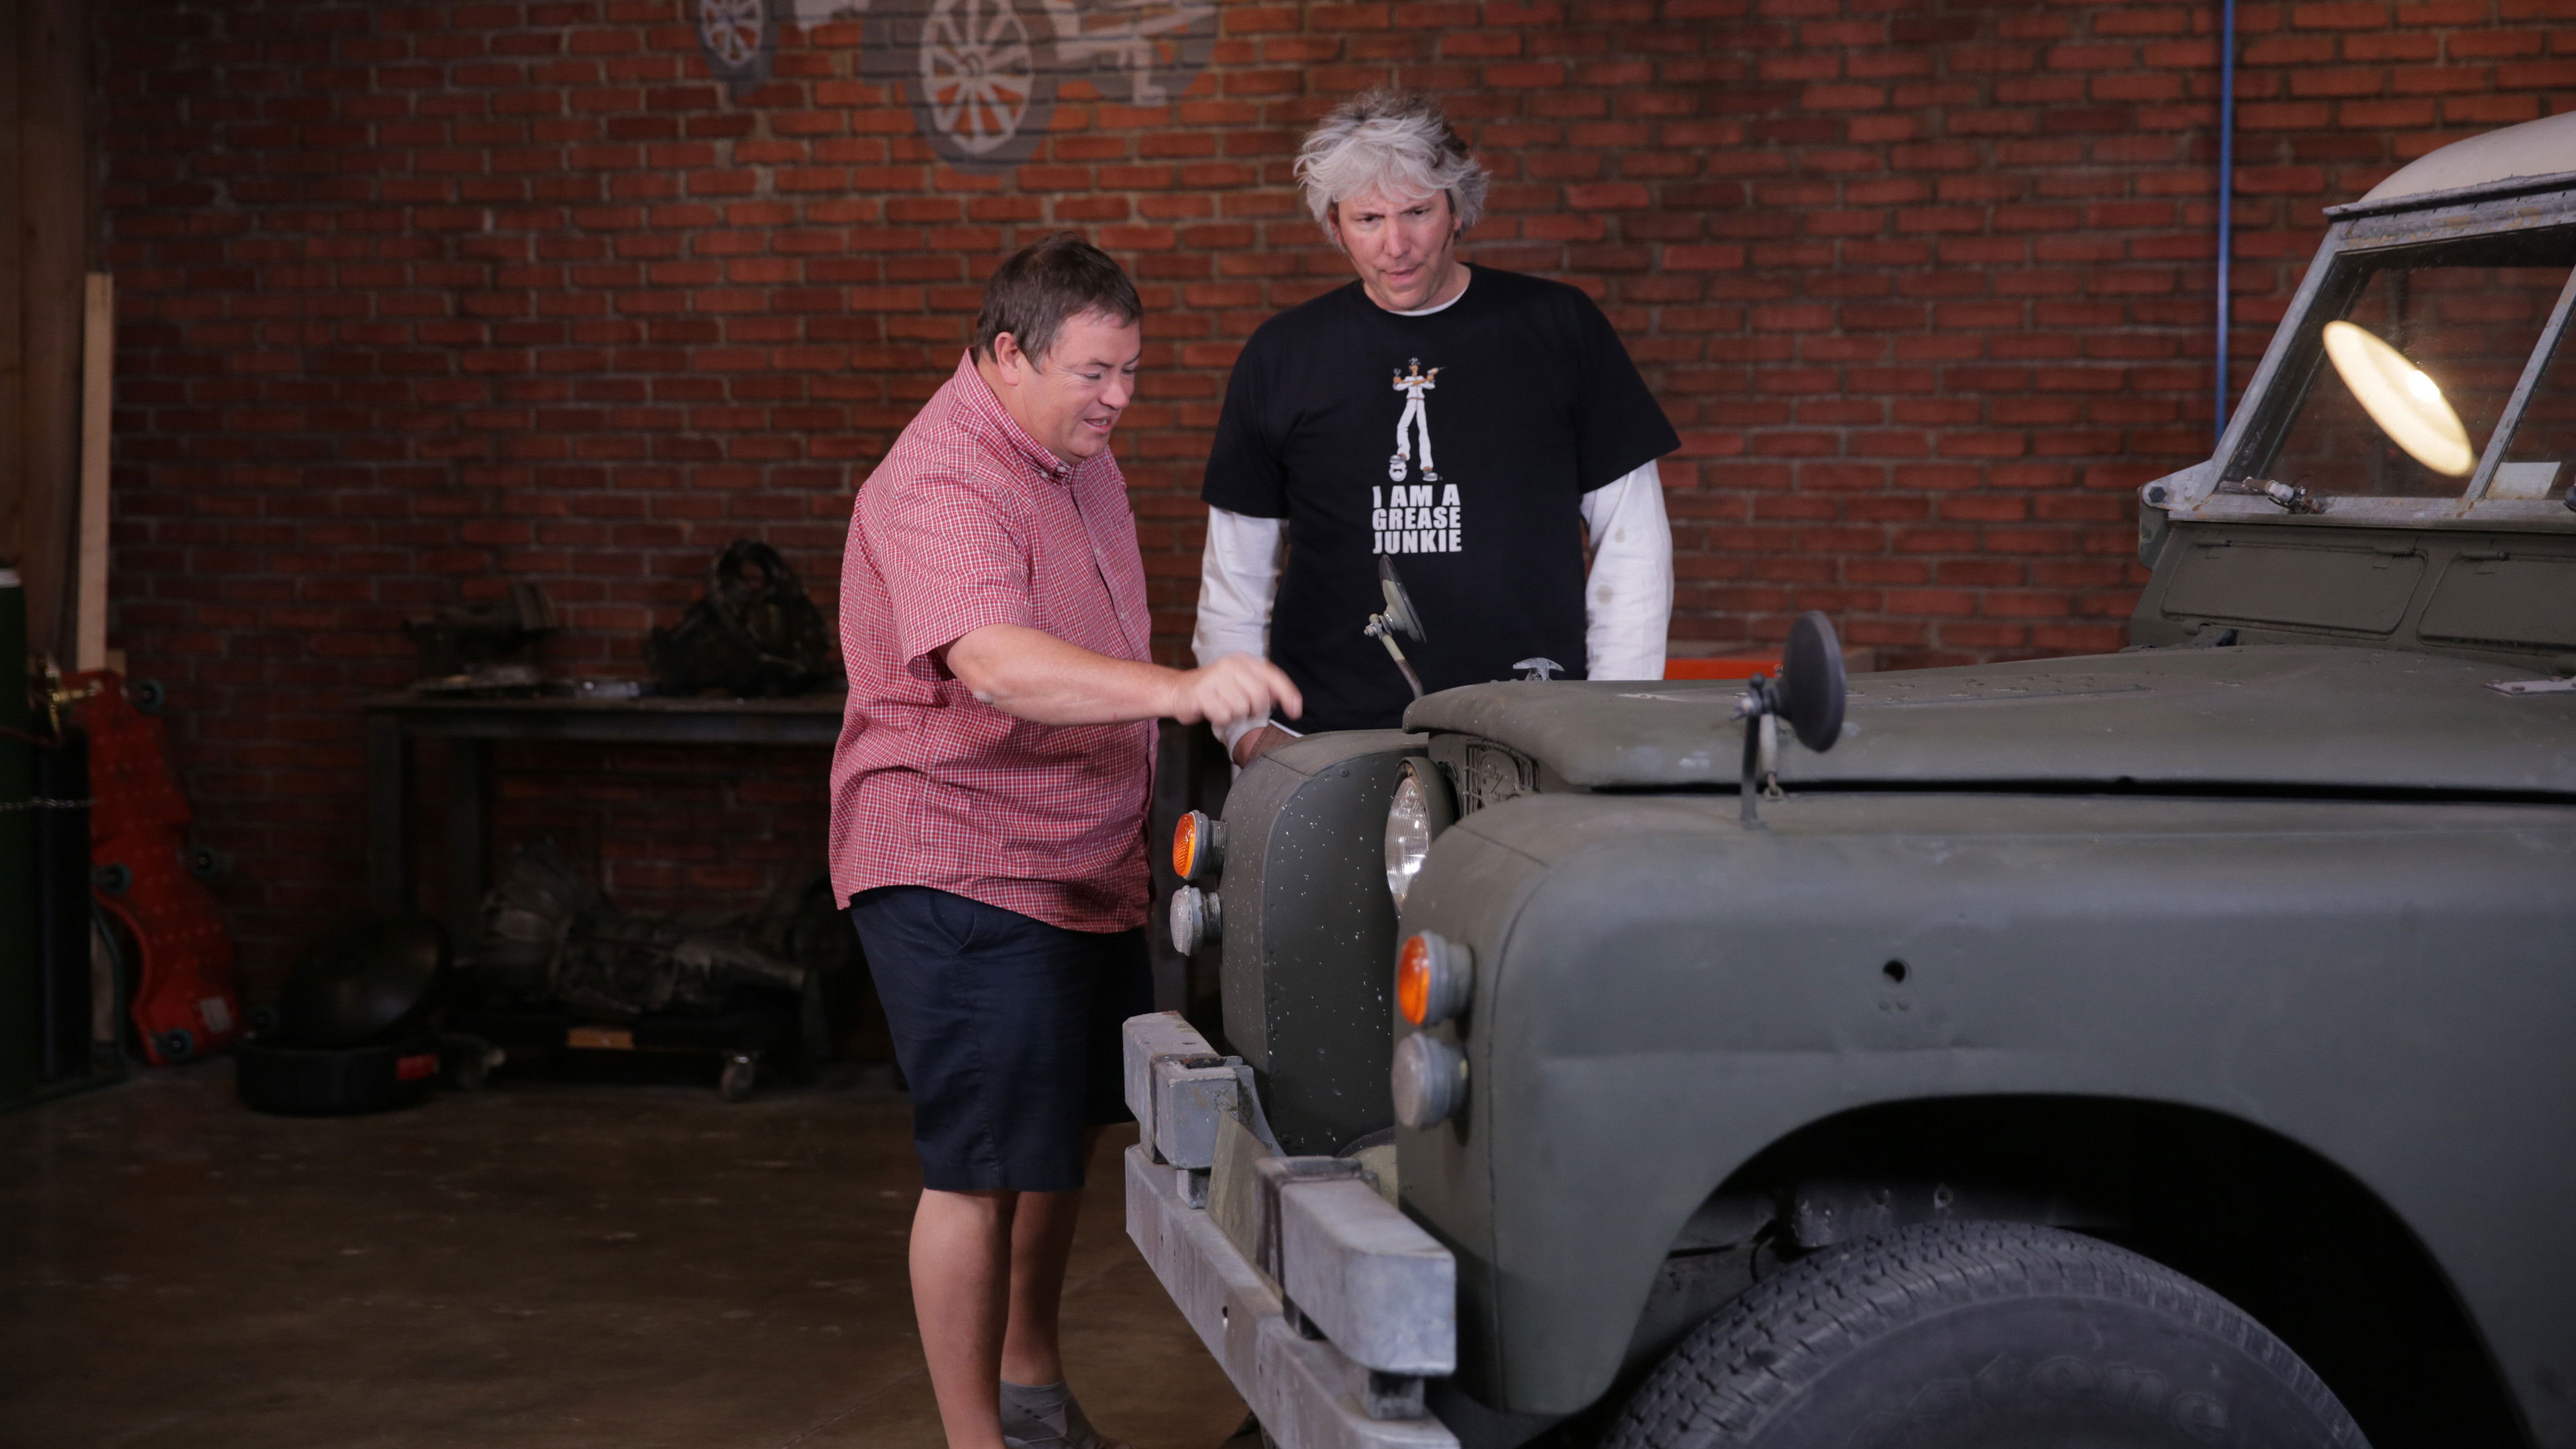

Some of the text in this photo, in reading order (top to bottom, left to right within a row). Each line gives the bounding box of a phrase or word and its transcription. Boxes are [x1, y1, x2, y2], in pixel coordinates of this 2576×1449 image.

[1372, 483, 1461, 508] I AM A
[1372, 506, 1462, 531] GREASE
[1373, 529, 1462, 555] JUNKIE
